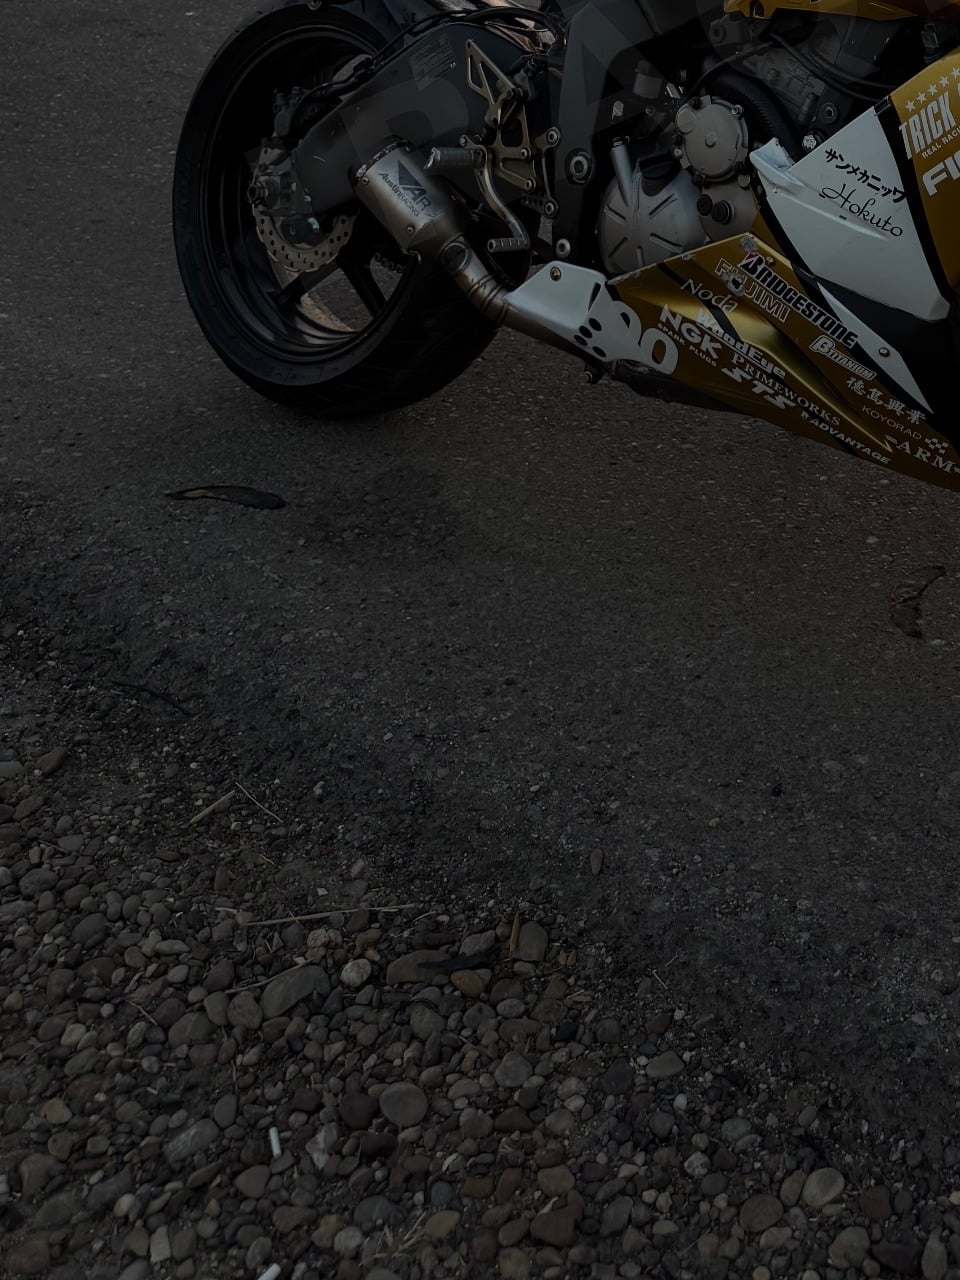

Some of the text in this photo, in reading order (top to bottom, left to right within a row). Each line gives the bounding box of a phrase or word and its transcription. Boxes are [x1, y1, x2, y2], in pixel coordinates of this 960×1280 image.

[899, 91, 957, 161] TRICK
[921, 141, 942, 159] REAL
[825, 148, 907, 203] サンメカニック
[821, 183, 903, 237] Hokuto
[680, 278, 738, 313] Noda
[738, 252, 859, 350] BRIDGESTONE
[658, 322, 718, 368] SPARK PLUGS
[660, 304, 722, 360] NGK
[731, 352, 842, 427] PRIMEWORKS
[862, 405, 922, 440] KOYORAD
